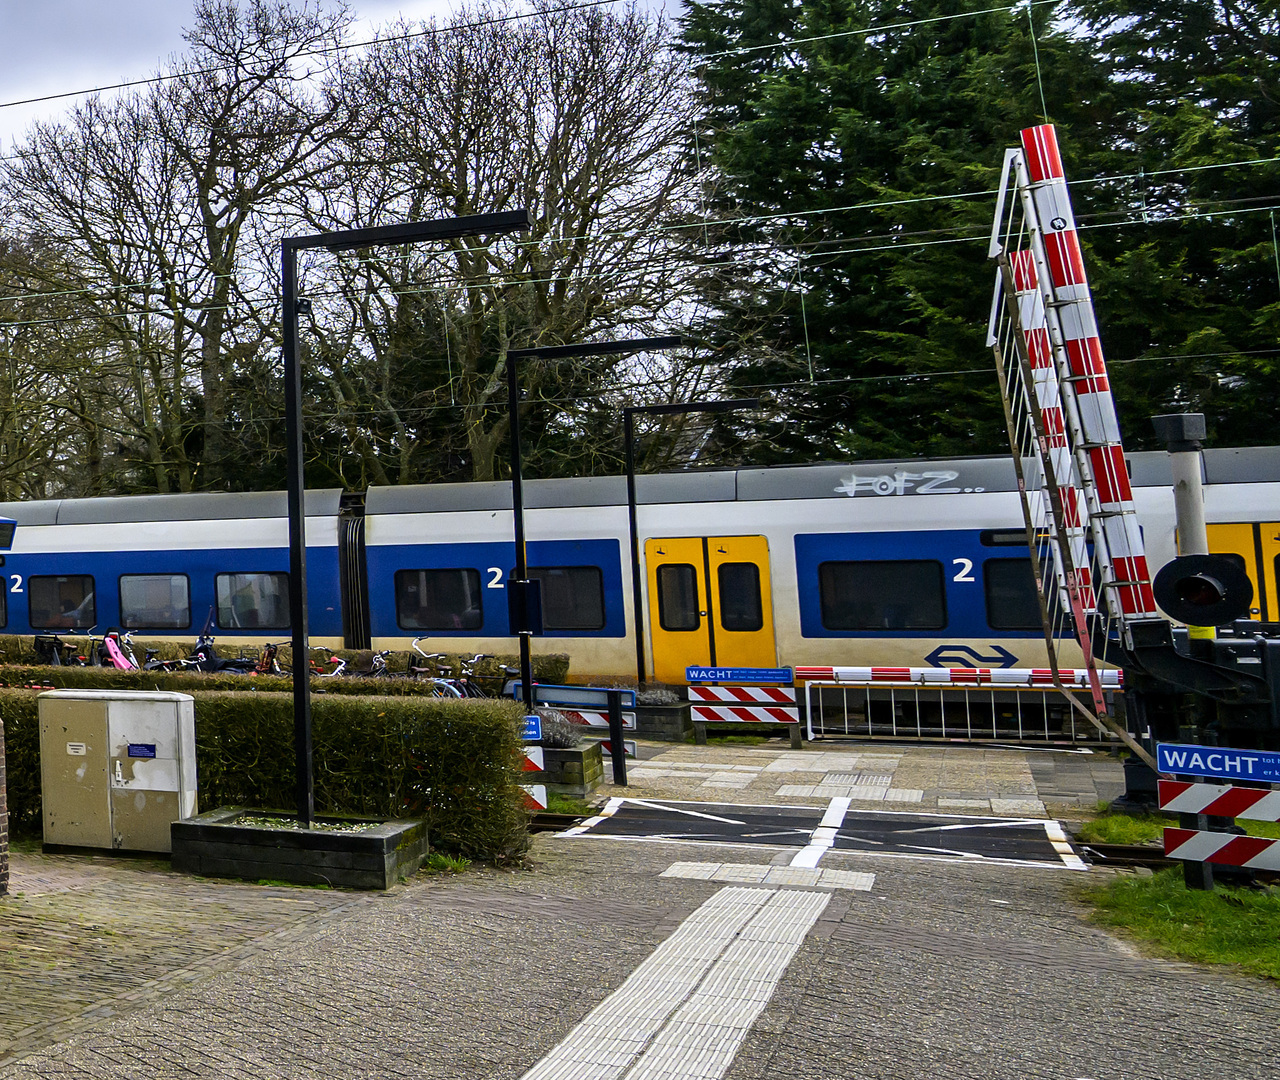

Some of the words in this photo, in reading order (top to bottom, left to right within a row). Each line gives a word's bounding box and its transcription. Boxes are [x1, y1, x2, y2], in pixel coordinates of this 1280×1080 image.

[487, 567, 504, 588] 2
[952, 558, 975, 582] 2
[10, 574, 23, 593] 2
[689, 670, 732, 679] WACHT
[1163, 750, 1259, 774] WACHT
